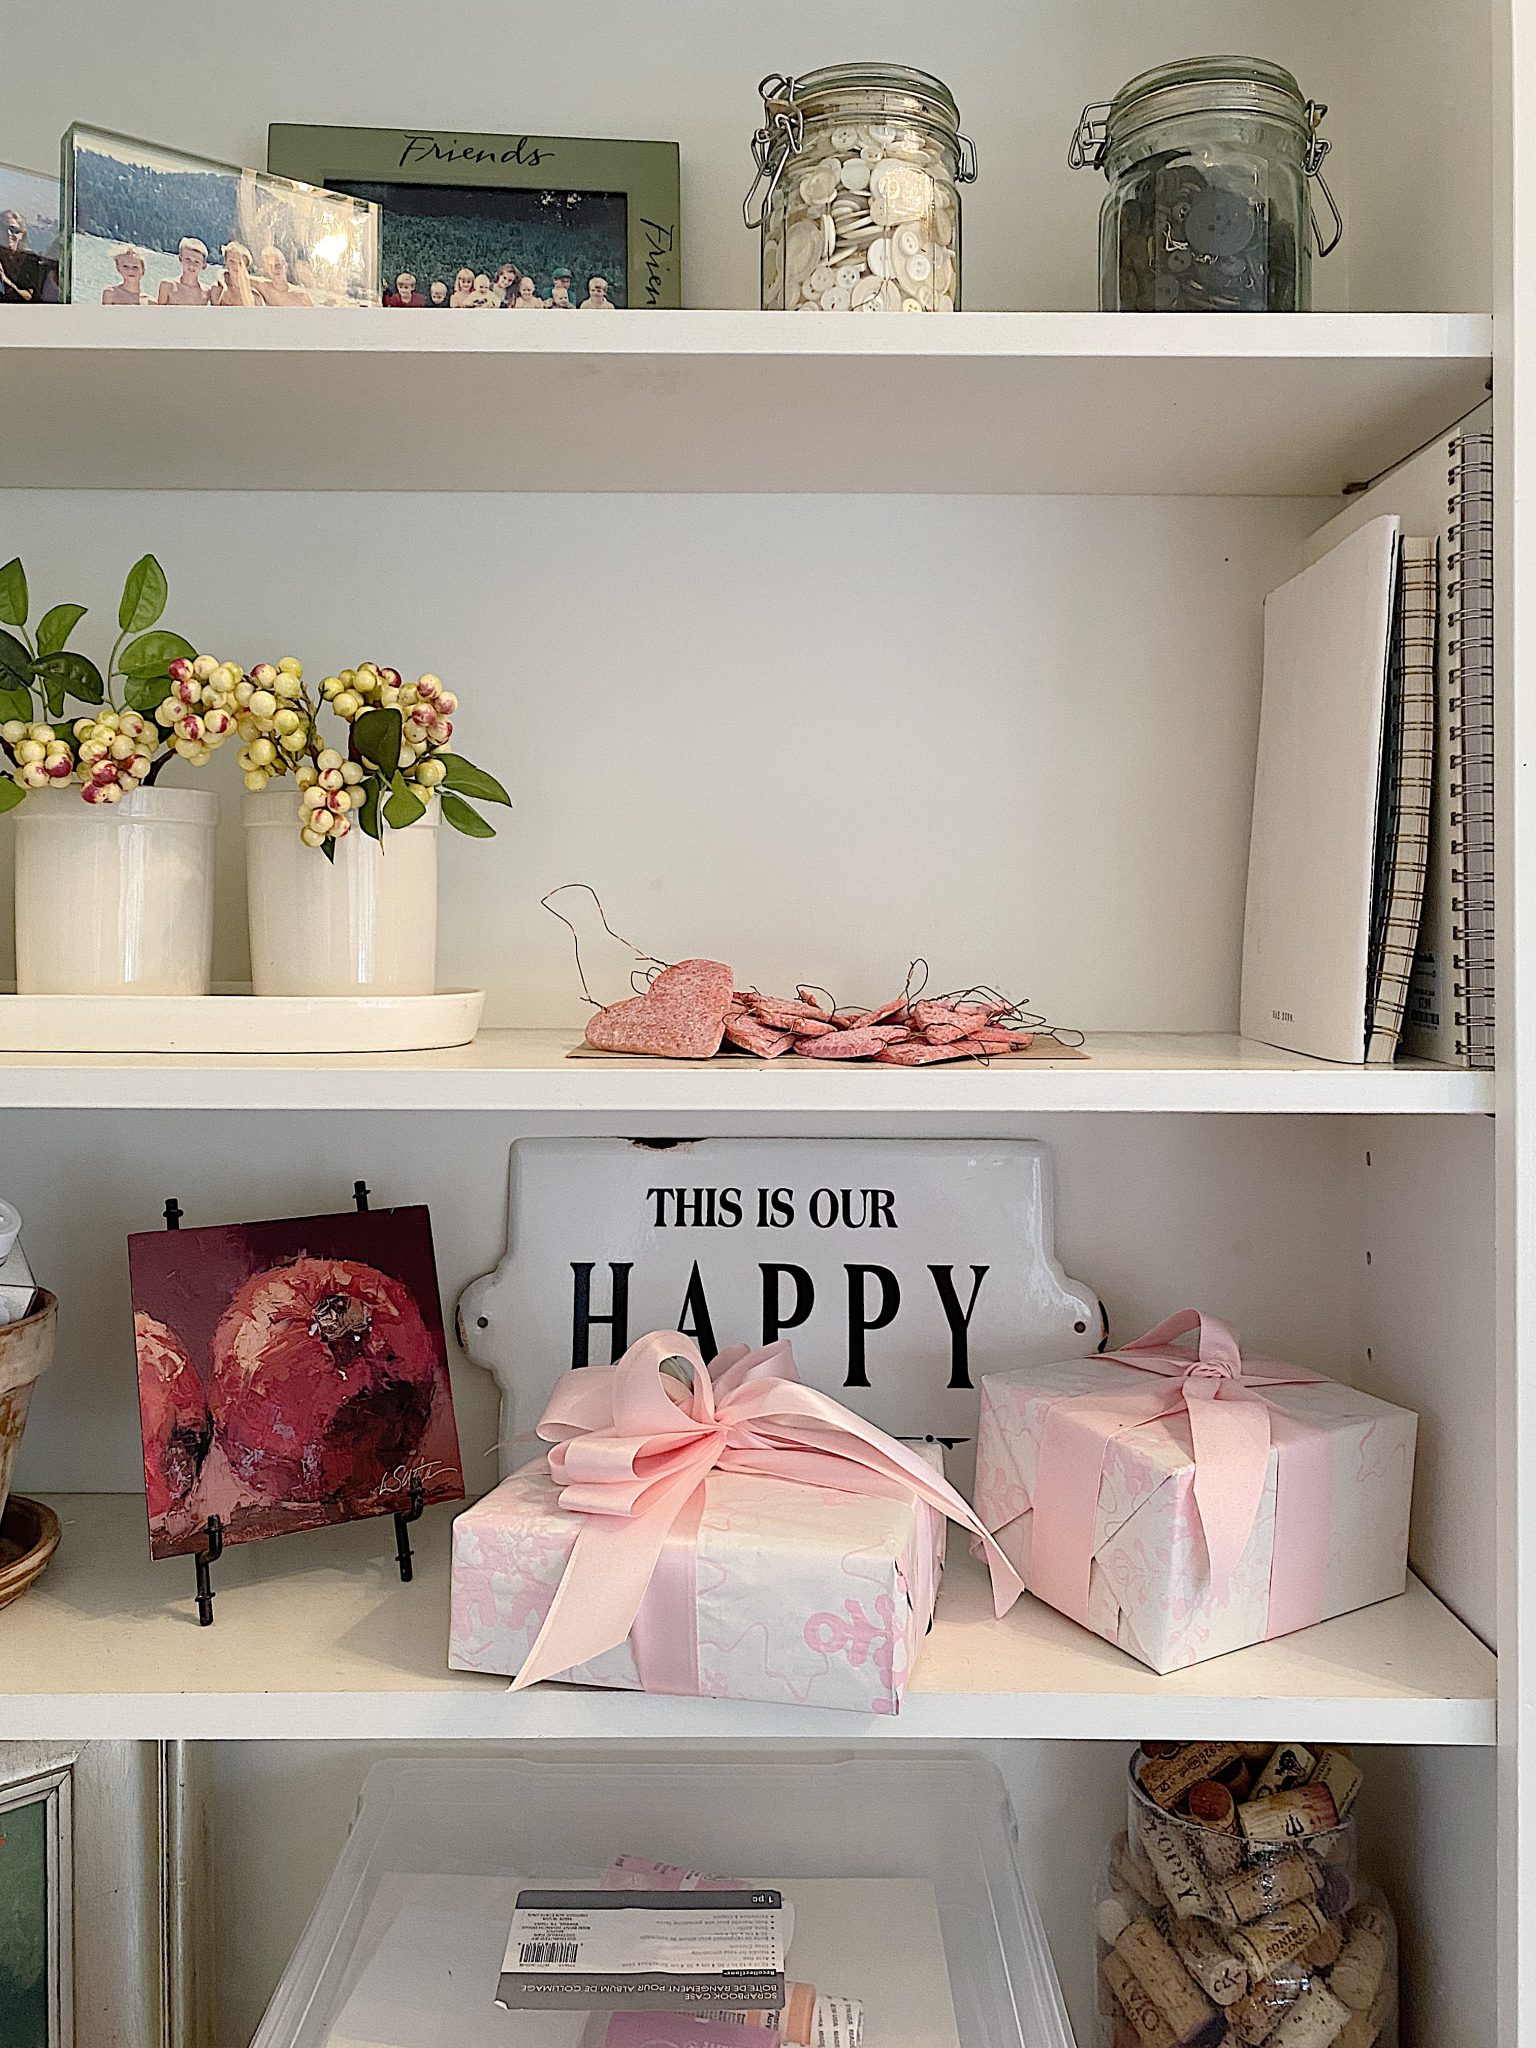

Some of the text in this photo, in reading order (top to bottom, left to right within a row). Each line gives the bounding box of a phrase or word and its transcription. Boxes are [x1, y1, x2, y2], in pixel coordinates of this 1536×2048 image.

[399, 134, 556, 168] Friends
[639, 217, 675, 305] Frien
[646, 1187, 898, 1230] THIS IS OUR
[569, 1259, 991, 1390] HAPPY
[752, 1894, 774, 1904] 1 pc
[521, 1984, 582, 1992] COLLIMAGE
[584, 1984, 598, 1992] DE
[600, 1984, 635, 1993] ALBUM
[637, 1984, 667, 1992] POUR
[668, 1984, 731, 1992] RANGEMENT
[734, 1984, 748, 1992] DE
[685, 1992, 777, 2000] SCRAPBOOK CASE
